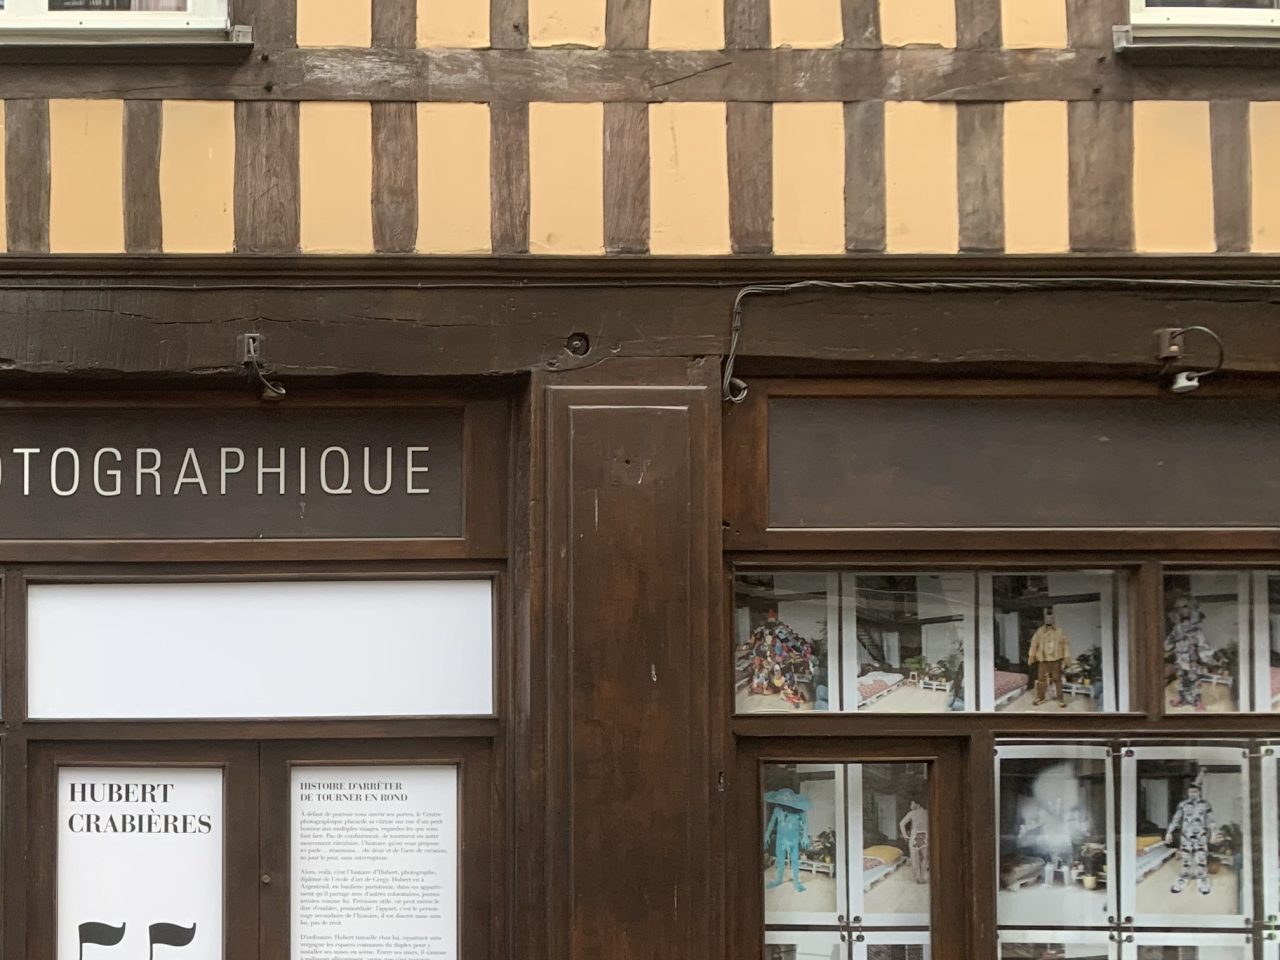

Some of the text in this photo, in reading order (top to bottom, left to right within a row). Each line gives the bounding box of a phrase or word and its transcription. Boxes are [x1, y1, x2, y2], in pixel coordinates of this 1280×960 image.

[69, 783, 174, 803] HUBERT
[300, 780, 402, 790] HISTOIRE D'ARRÊTER
[68, 809, 212, 834] CRABIÈRES
